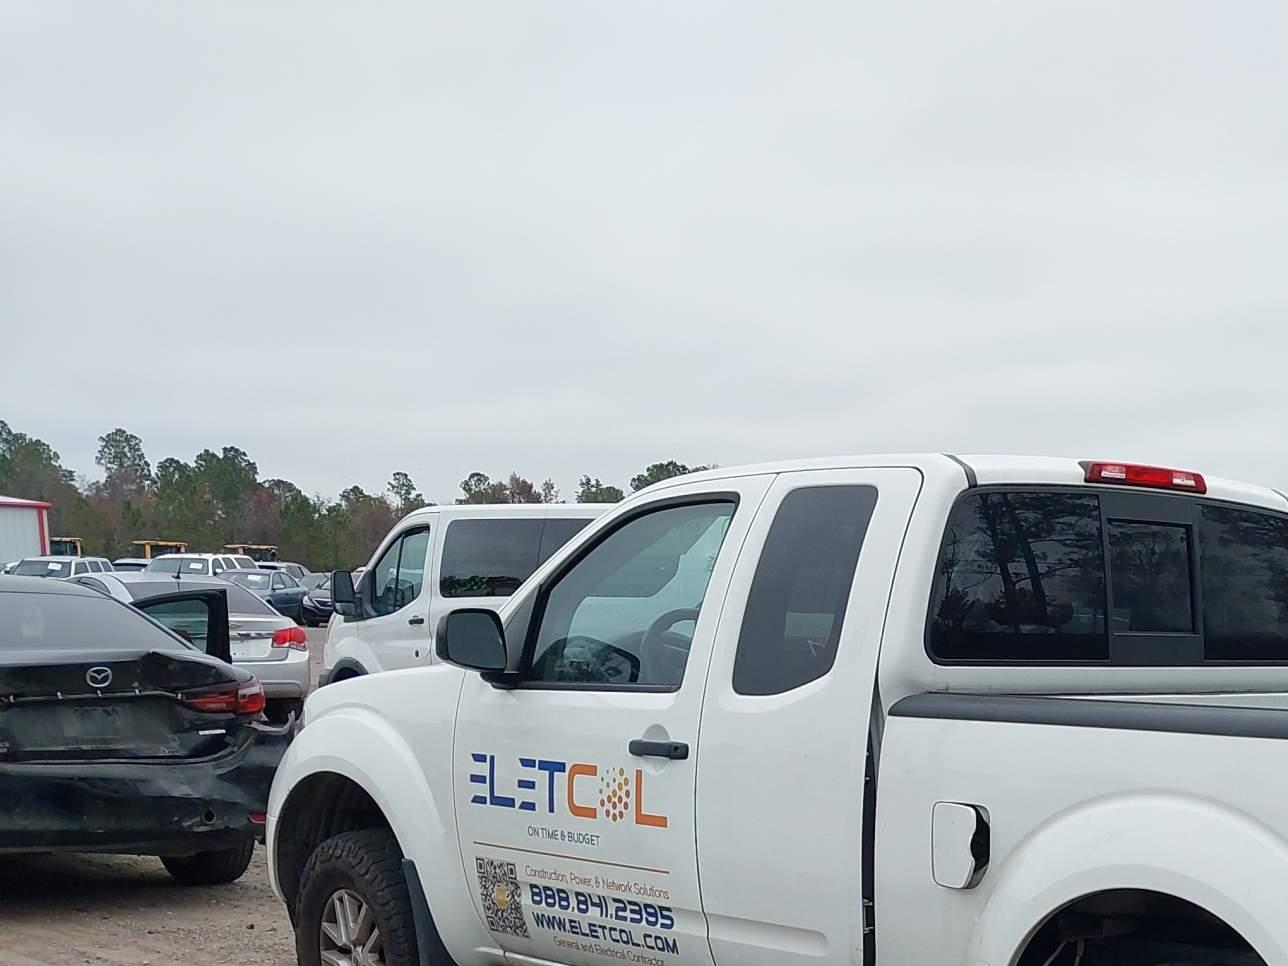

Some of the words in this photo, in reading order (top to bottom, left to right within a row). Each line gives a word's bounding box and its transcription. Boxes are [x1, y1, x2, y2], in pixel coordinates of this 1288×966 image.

[470, 753, 668, 828] ELETCOL
[527, 825, 540, 838] ON
[541, 827, 559, 841] TIME
[560, 832, 566, 842] &
[567, 831, 601, 846] BUDGET
[594, 876, 600, 888] &
[602, 877, 633, 894] Network
[634, 884, 670, 900] Solutions
[529, 883, 675, 930] 888.841.2395
[532, 911, 679, 955] WWW.ELETCOL.COM
[553, 935, 580, 951] General
[581, 942, 594, 954] and
[595, 943, 626, 961] Electrical
